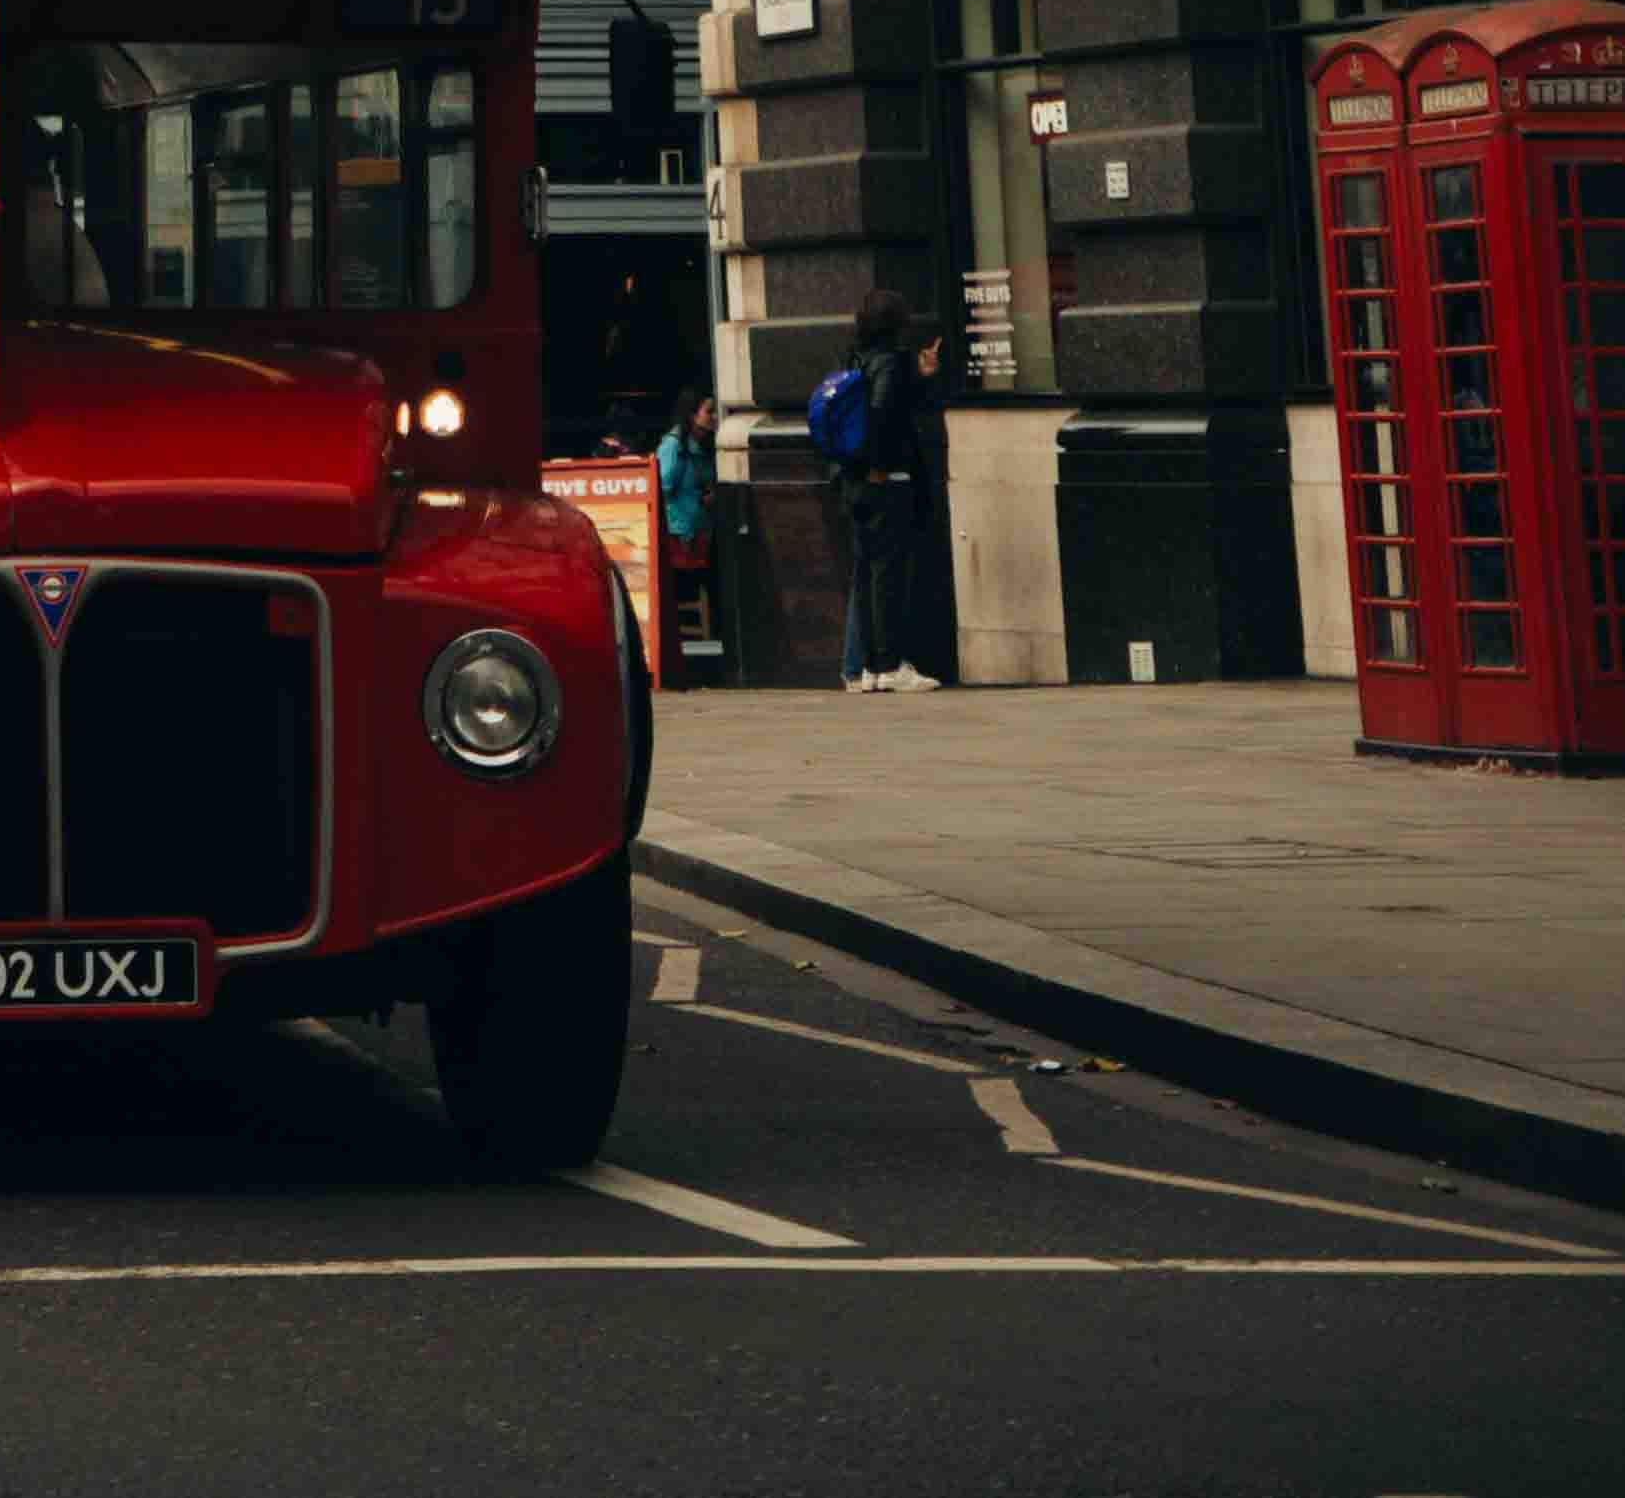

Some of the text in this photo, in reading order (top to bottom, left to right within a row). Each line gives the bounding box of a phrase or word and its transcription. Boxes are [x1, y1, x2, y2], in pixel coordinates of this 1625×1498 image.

[541, 477, 649, 497] FIVE GUYS
[55, 950, 164, 997] UXJ
